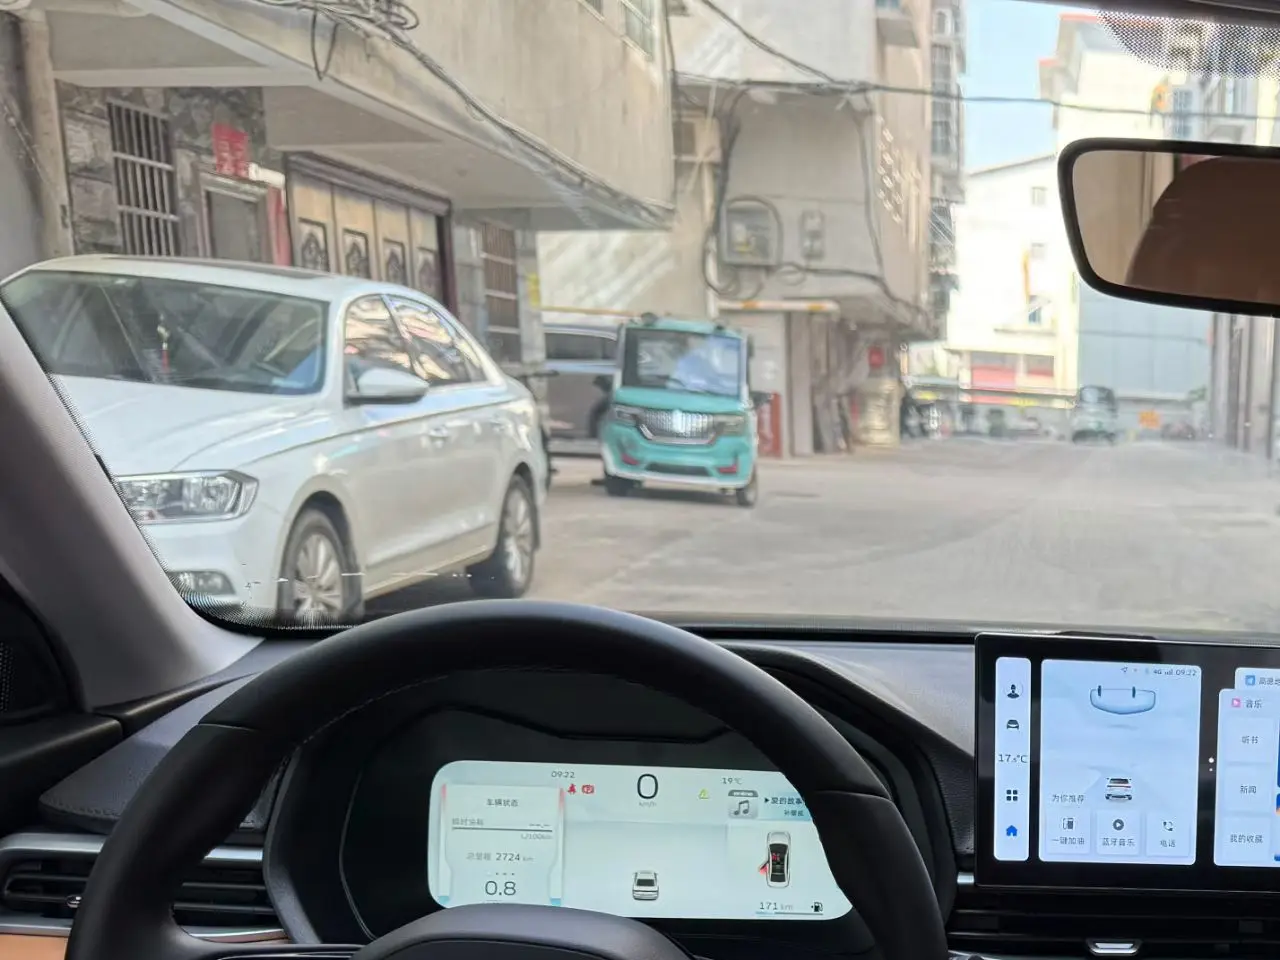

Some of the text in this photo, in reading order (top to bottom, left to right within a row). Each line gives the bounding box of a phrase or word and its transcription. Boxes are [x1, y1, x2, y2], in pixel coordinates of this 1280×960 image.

[1246, 700, 1262, 709] 音乐
[1241, 735, 1259, 744] 听书
[551, 771, 576, 779] 09:22
[637, 773, 659, 800] 0
[1240, 785, 1257, 794] 新闻
[486, 798, 519, 808] 车辆状态
[1052, 794, 1085, 803] 为你推荐
[1052, 836, 1085, 846] 一键加油
[1101, 838, 1136, 848] 蓝牙音乐
[1159, 839, 1176, 848] 电话
[1230, 834, 1263, 844] 我的收藏
[495, 852, 521, 862] 2724
[485, 880, 517, 896] 0.8
[760, 902, 778, 910] 171
